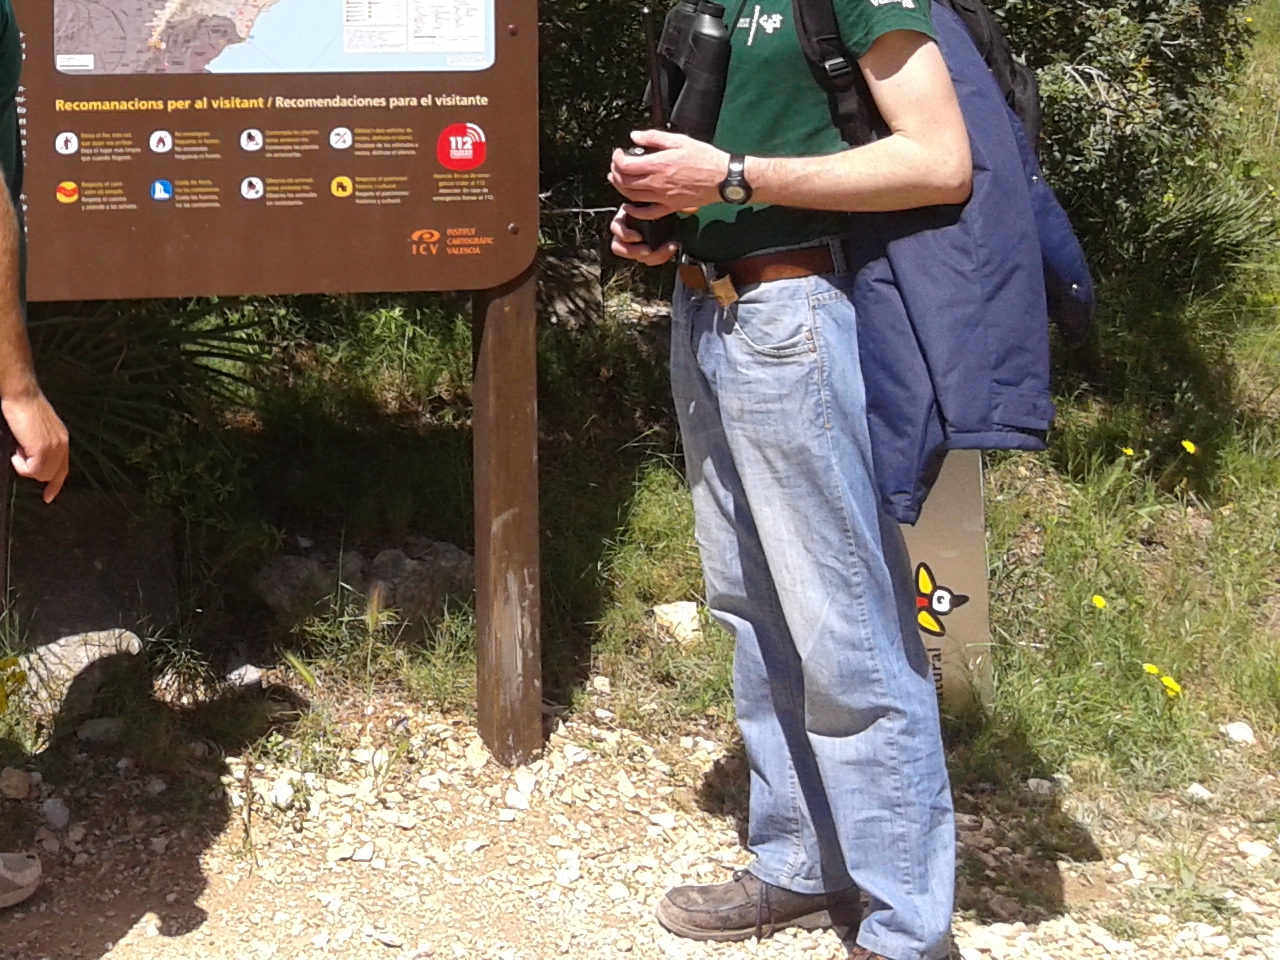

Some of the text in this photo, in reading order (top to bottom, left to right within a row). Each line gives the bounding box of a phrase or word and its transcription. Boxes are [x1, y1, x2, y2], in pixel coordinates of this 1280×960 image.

[55, 98, 164, 111] Recomanacions
[168, 99, 192, 112] per
[194, 97, 208, 110] al
[212, 96, 264, 110] visitant
[275, 94, 386, 108] Recomendaciones
[390, 96, 418, 110] para
[420, 94, 432, 107] el
[436, 94, 488, 106] visitante
[449, 136, 473, 149] 112
[446, 228, 476, 236] INSTITUT
